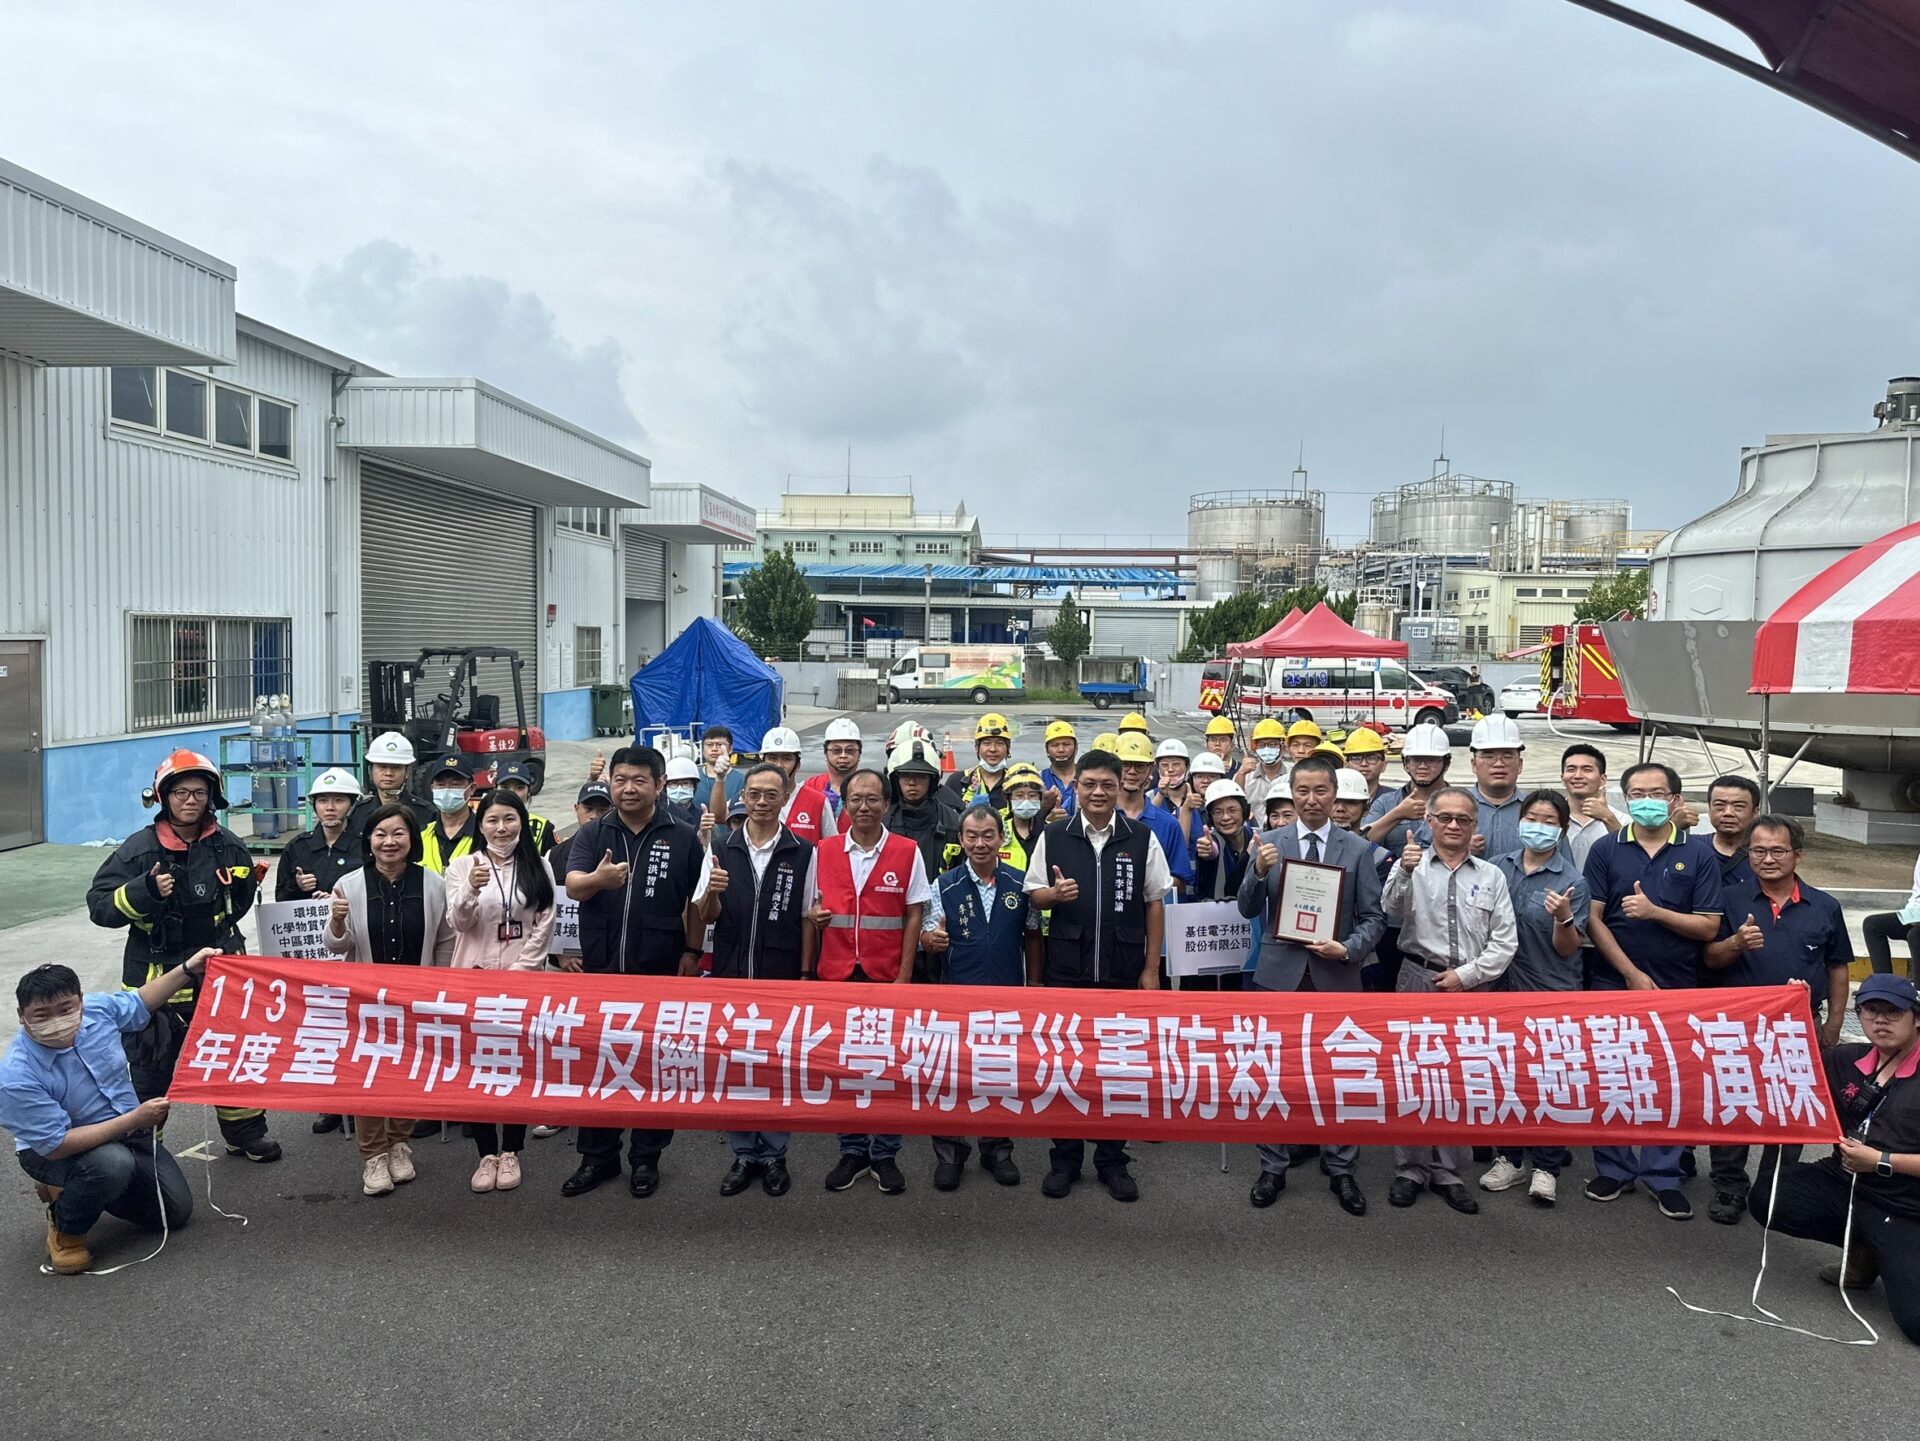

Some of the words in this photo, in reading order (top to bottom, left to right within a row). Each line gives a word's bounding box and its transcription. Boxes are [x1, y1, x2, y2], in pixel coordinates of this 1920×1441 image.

[1304, 671, 1327, 687] 119
[488, 738, 515, 752] 基佳2
[587, 784, 609, 794] FILA
[293, 904, 329, 918] 環境部
[1185, 923, 1252, 938] 基佳電子材料
[1185, 938, 1252, 953] 股份有限公司
[210, 975, 287, 1023] 113
[188, 1028, 282, 1085] 年度
